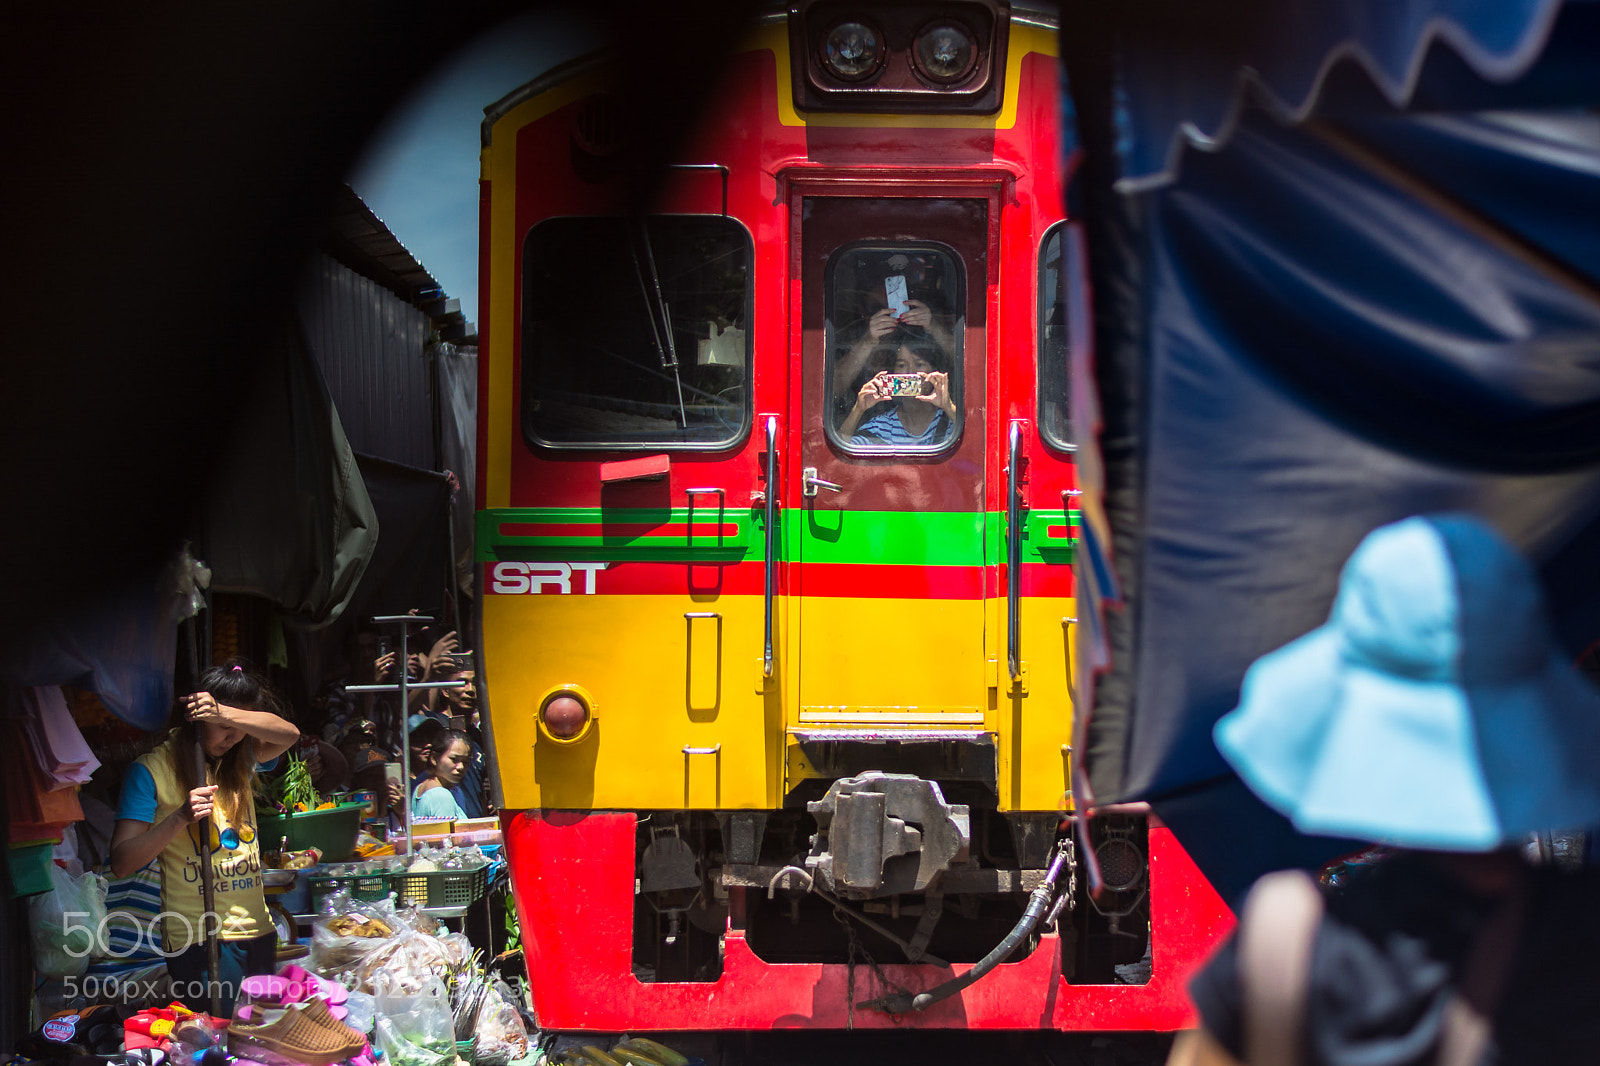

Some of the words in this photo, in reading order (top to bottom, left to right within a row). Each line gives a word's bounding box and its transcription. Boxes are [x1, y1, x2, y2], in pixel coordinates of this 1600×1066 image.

[493, 562, 610, 594] SRT
[198, 881, 229, 895] BKE
[232, 877, 253, 890] FOR
